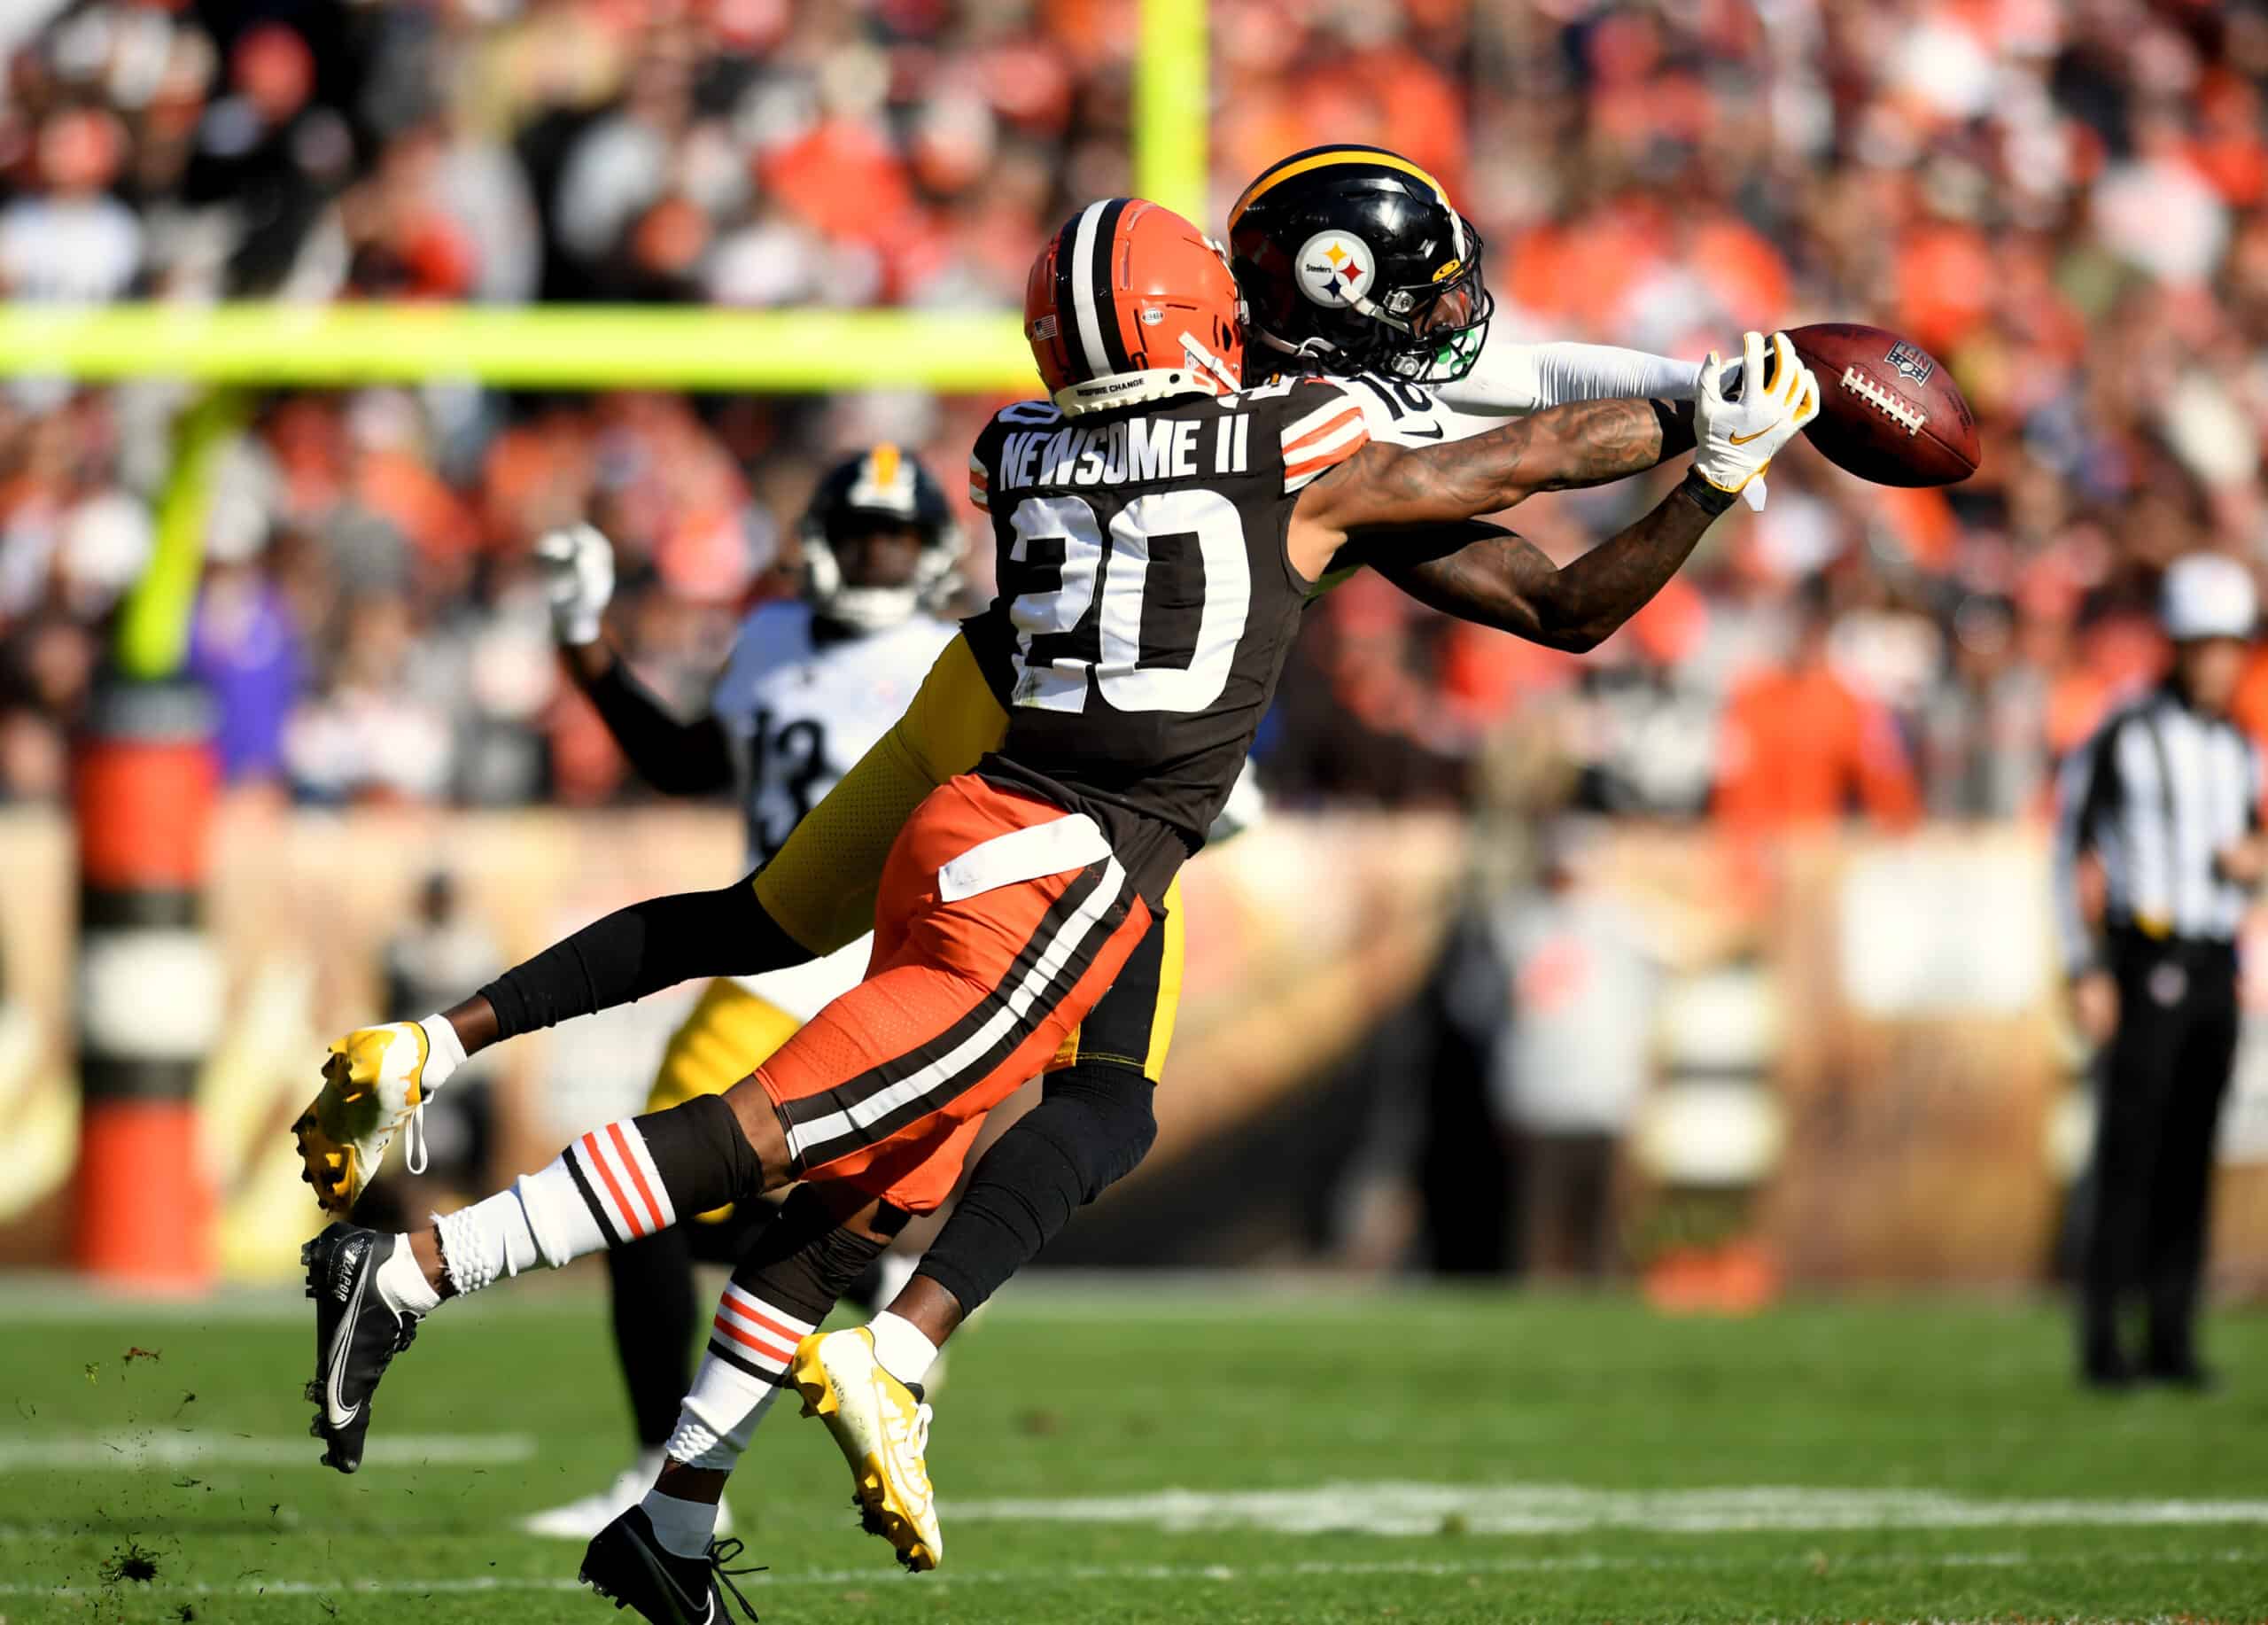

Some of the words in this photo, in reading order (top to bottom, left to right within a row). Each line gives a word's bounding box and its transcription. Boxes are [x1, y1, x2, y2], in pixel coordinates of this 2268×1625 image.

[1306, 263, 1332, 274] Steelers
[1108, 377, 1145, 393] CHANGE
[999, 418, 1202, 491] NEWSOME
[1215, 413, 1250, 474] II
[1009, 488, 1252, 714] 20
[337, 1256, 356, 1303] VAPOR
